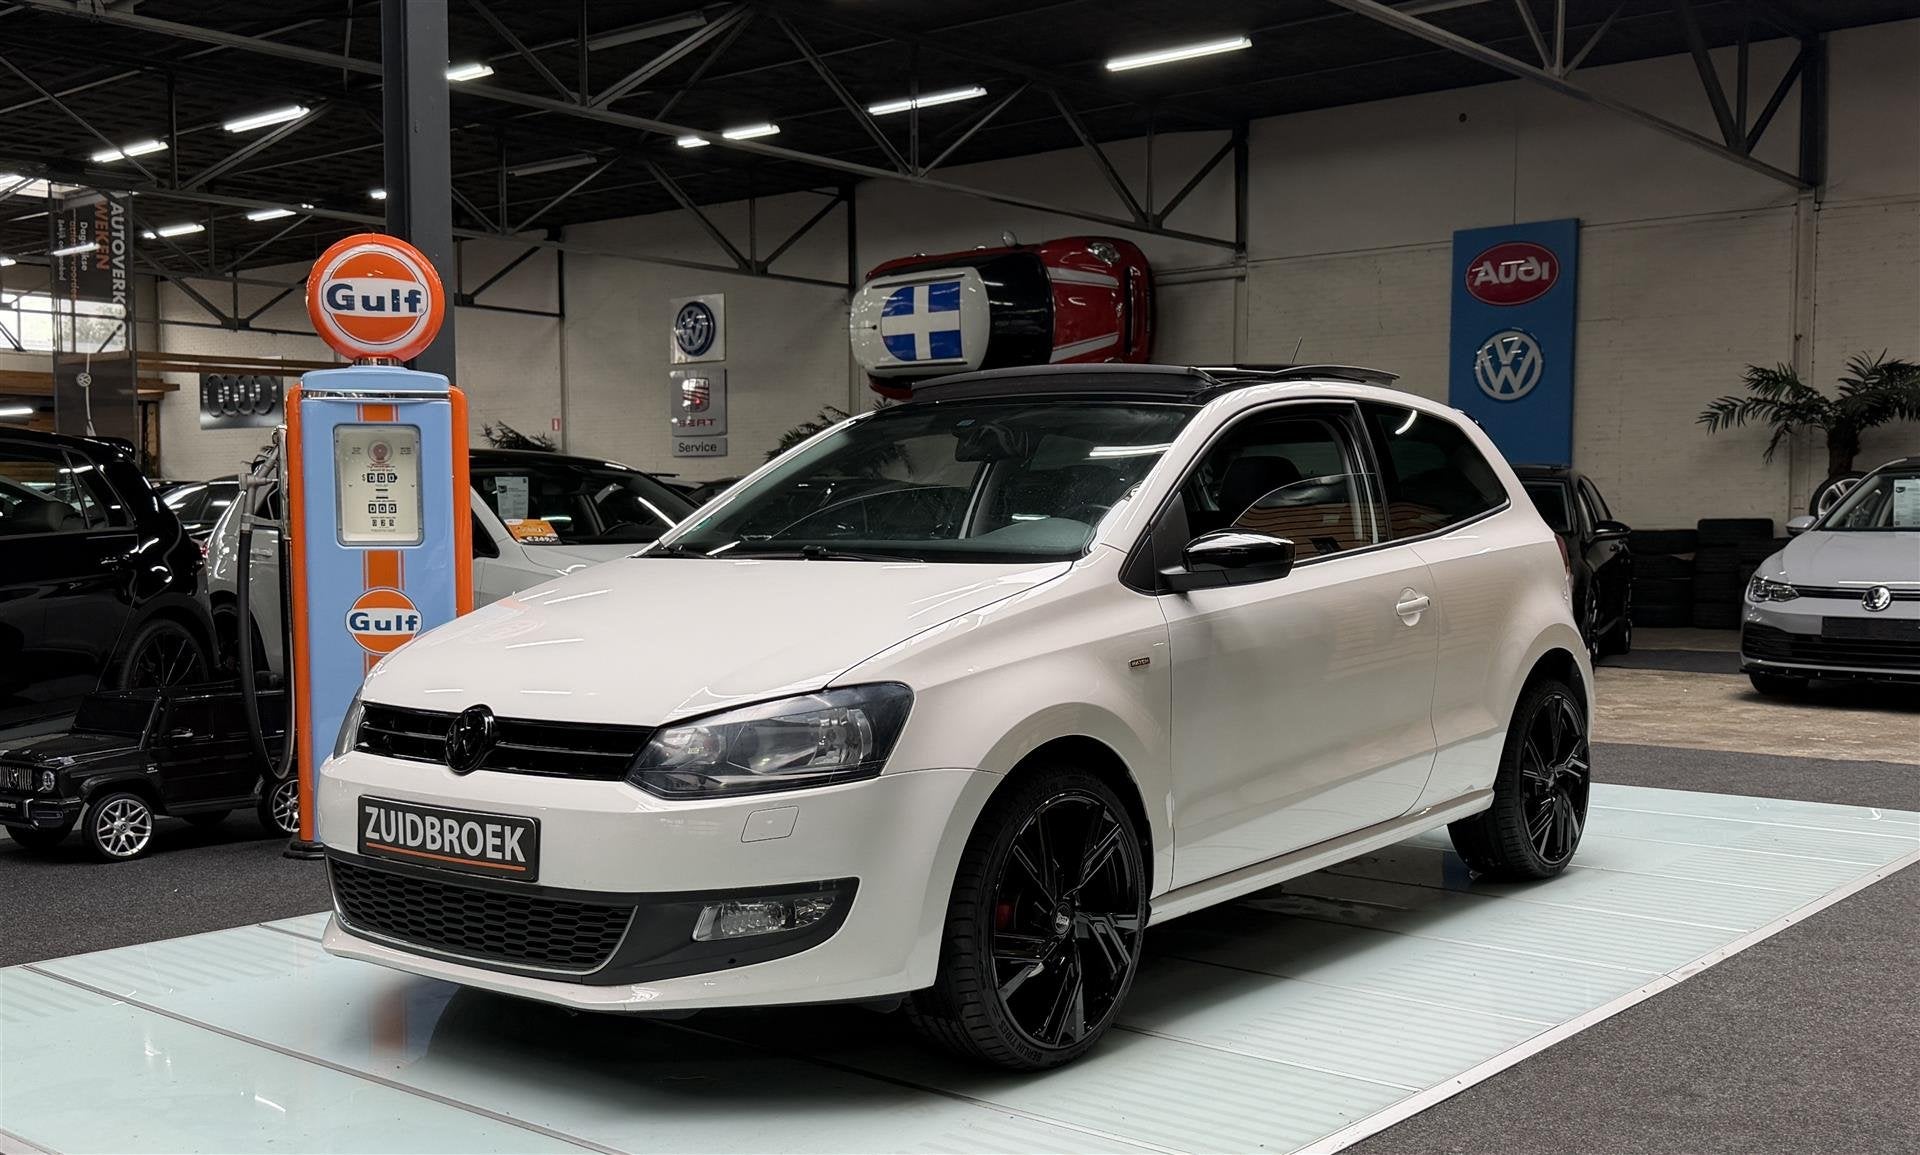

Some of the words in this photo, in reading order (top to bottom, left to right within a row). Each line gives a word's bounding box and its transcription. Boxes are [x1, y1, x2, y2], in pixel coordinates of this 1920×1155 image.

[95, 201, 110, 270] WEKEN
[327, 283, 422, 313] Gulf
[678, 418, 717, 428] SEAT
[678, 442, 717, 453] Service
[349, 612, 418, 631] Gulf
[365, 806, 526, 863] ZUIDBROEK
